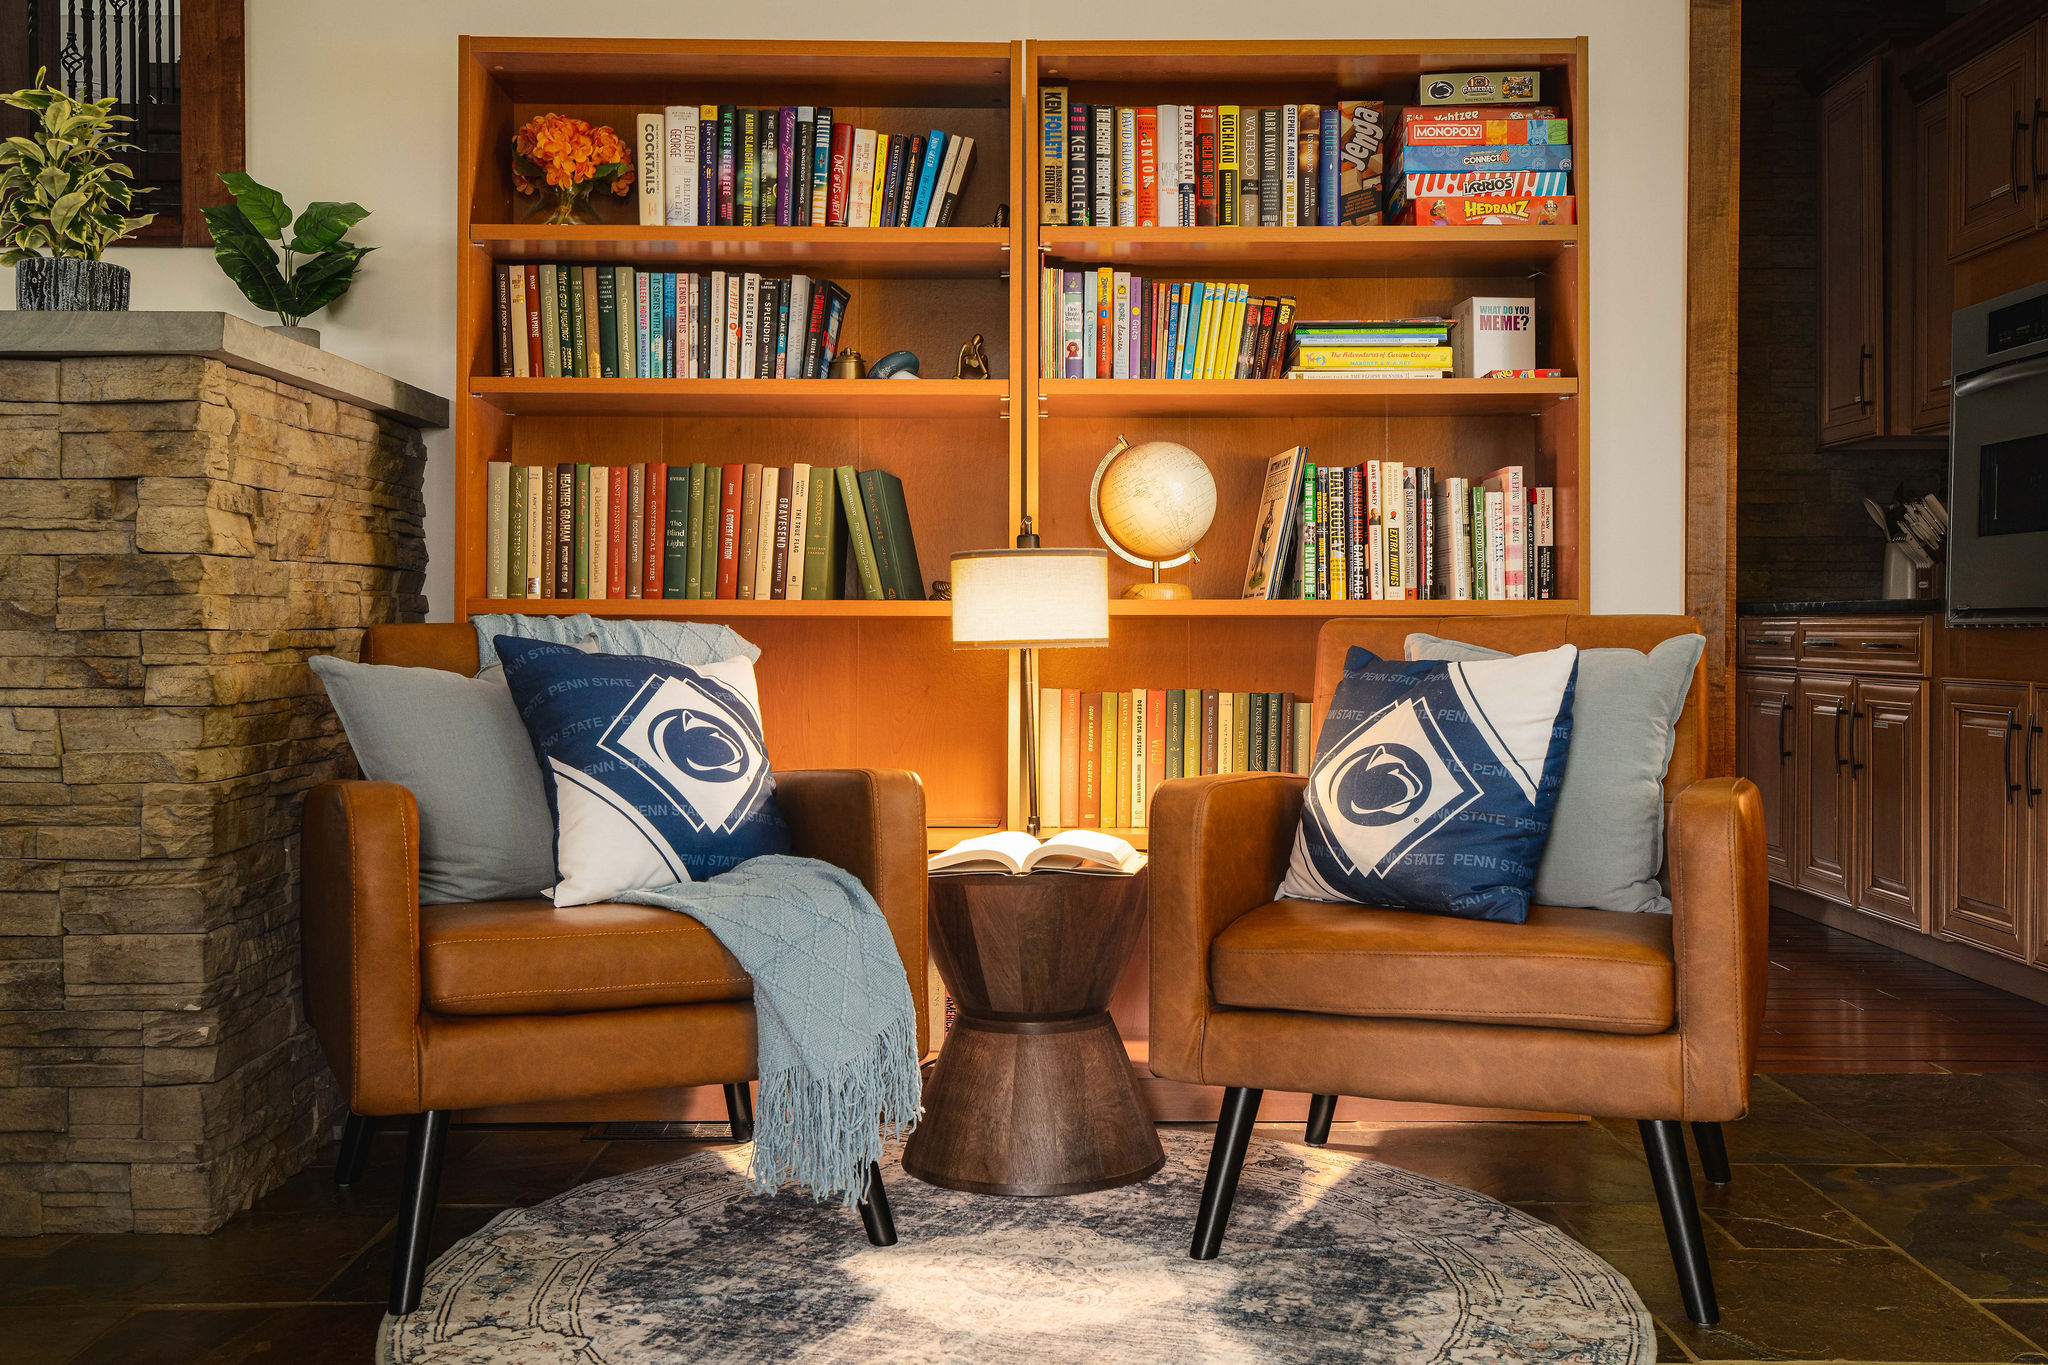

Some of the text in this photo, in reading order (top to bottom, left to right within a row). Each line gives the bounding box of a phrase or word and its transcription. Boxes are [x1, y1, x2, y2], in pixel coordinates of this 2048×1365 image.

[816, 115, 830, 147] FALLING
[1045, 92, 1062, 158] KEN FOLLETT
[1184, 109, 1193, 135] JOHN
[1265, 111, 1276, 132] DARK
[1288, 107, 1296, 137] STEPHEN
[1416, 126, 1480, 137] MONOPOLY
[670, 128, 682, 158] GEORGE
[684, 125, 697, 164] ELIZABETH
[1121, 112, 1132, 185] DAVID BALDACCI
[1222, 114, 1234, 163] KOCHLAND
[1245, 115, 1256, 176] WATERLOO
[1325, 118, 1338, 156] DECIDER
[1341, 106, 1384, 172] Jenga
[644, 123, 655, 195] COCKTAILS
[722, 112, 732, 195] WE WERE NEVER HERE
[744, 113, 754, 198] KARIN SLAUGHTER FALSE
[1096, 108, 1111, 194] THE DECEIVER FREDERICK
[1141, 138, 1154, 184] UNION
[1264, 134, 1276, 171] INVASION
[1287, 146, 1295, 179] AMBROSE
[1463, 149, 1510, 165] CONNECT 4
[1071, 135, 1086, 222] KEN FOLLETT
[1202, 135, 1214, 197] SHIELD AND SWORD
[831, 154, 844, 218] ONE OF US NEXT
[1045, 165, 1055, 203] FORTUNE
[1287, 181, 1295, 194] THE
[1463, 177, 1513, 194] SORRY!
[683, 177, 691, 223] BELIEVING
[941, 199, 952, 224] NABOKOV
[1286, 195, 1295, 212] WILD
[1464, 199, 1531, 217] HEDBANZ
[574, 293, 582, 312] South
[746, 293, 754, 319] GOLDEN
[811, 294, 824, 332] COWORKER
[1479, 305, 1530, 315] WHAT DO YOU
[531, 311, 539, 337] DAPHNE
[653, 330, 660, 338] US
[680, 324, 686, 333] US
[745, 321, 753, 347] COUPLE
[763, 302, 771, 343] SPLENDID
[1132, 319, 1140, 339] Guts
[1479, 315, 1530, 331] MEME?
[1330, 471, 1345, 497] DAN
[1512, 471, 1520, 501] KEEPING
[560, 473, 571, 542] HEATHER GRAHAM
[814, 479, 824, 526] CROSSROADS
[1406, 490, 1414, 526] SLAM-DUNK
[513, 512, 521, 556] QUENTINS
[594, 529, 601, 537] of
[667, 529, 685, 537] Blind
[725, 514, 734, 536] COVERT
[777, 497, 788, 548] GRAVESEND
[1330, 501, 1345, 553] ROONEY
[1353, 471, 1364, 598] BERNARD KING GAME FACE
[1427, 528, 1432, 544] OF
[1495, 500, 1503, 562] TEAM TALK
[1512, 517, 1520, 543] BALANCE
[667, 539, 685, 548] Light
[724, 537, 733, 559] ACTION
[1406, 527, 1414, 554] SUCCESS
[592, 540, 601, 583] Disruption
[1305, 547, 1315, 584] NAMATH
[1390, 528, 1399, 586] EXTRA INNINGS
[548, 677, 635, 697] PENN STATE
[1360, 672, 1422, 686] PENN STATE
[561, 716, 605, 739] STATE
[1338, 709, 1365, 721] STATE
[1152, 739, 1162, 764] WILD
[748, 812, 773, 825] STATE
[1458, 810, 1506, 826] STATE
[708, 855, 745, 868] STATE
[1404, 853, 1496, 869] STATE PENN
[1450, 892, 1493, 911] STATE
